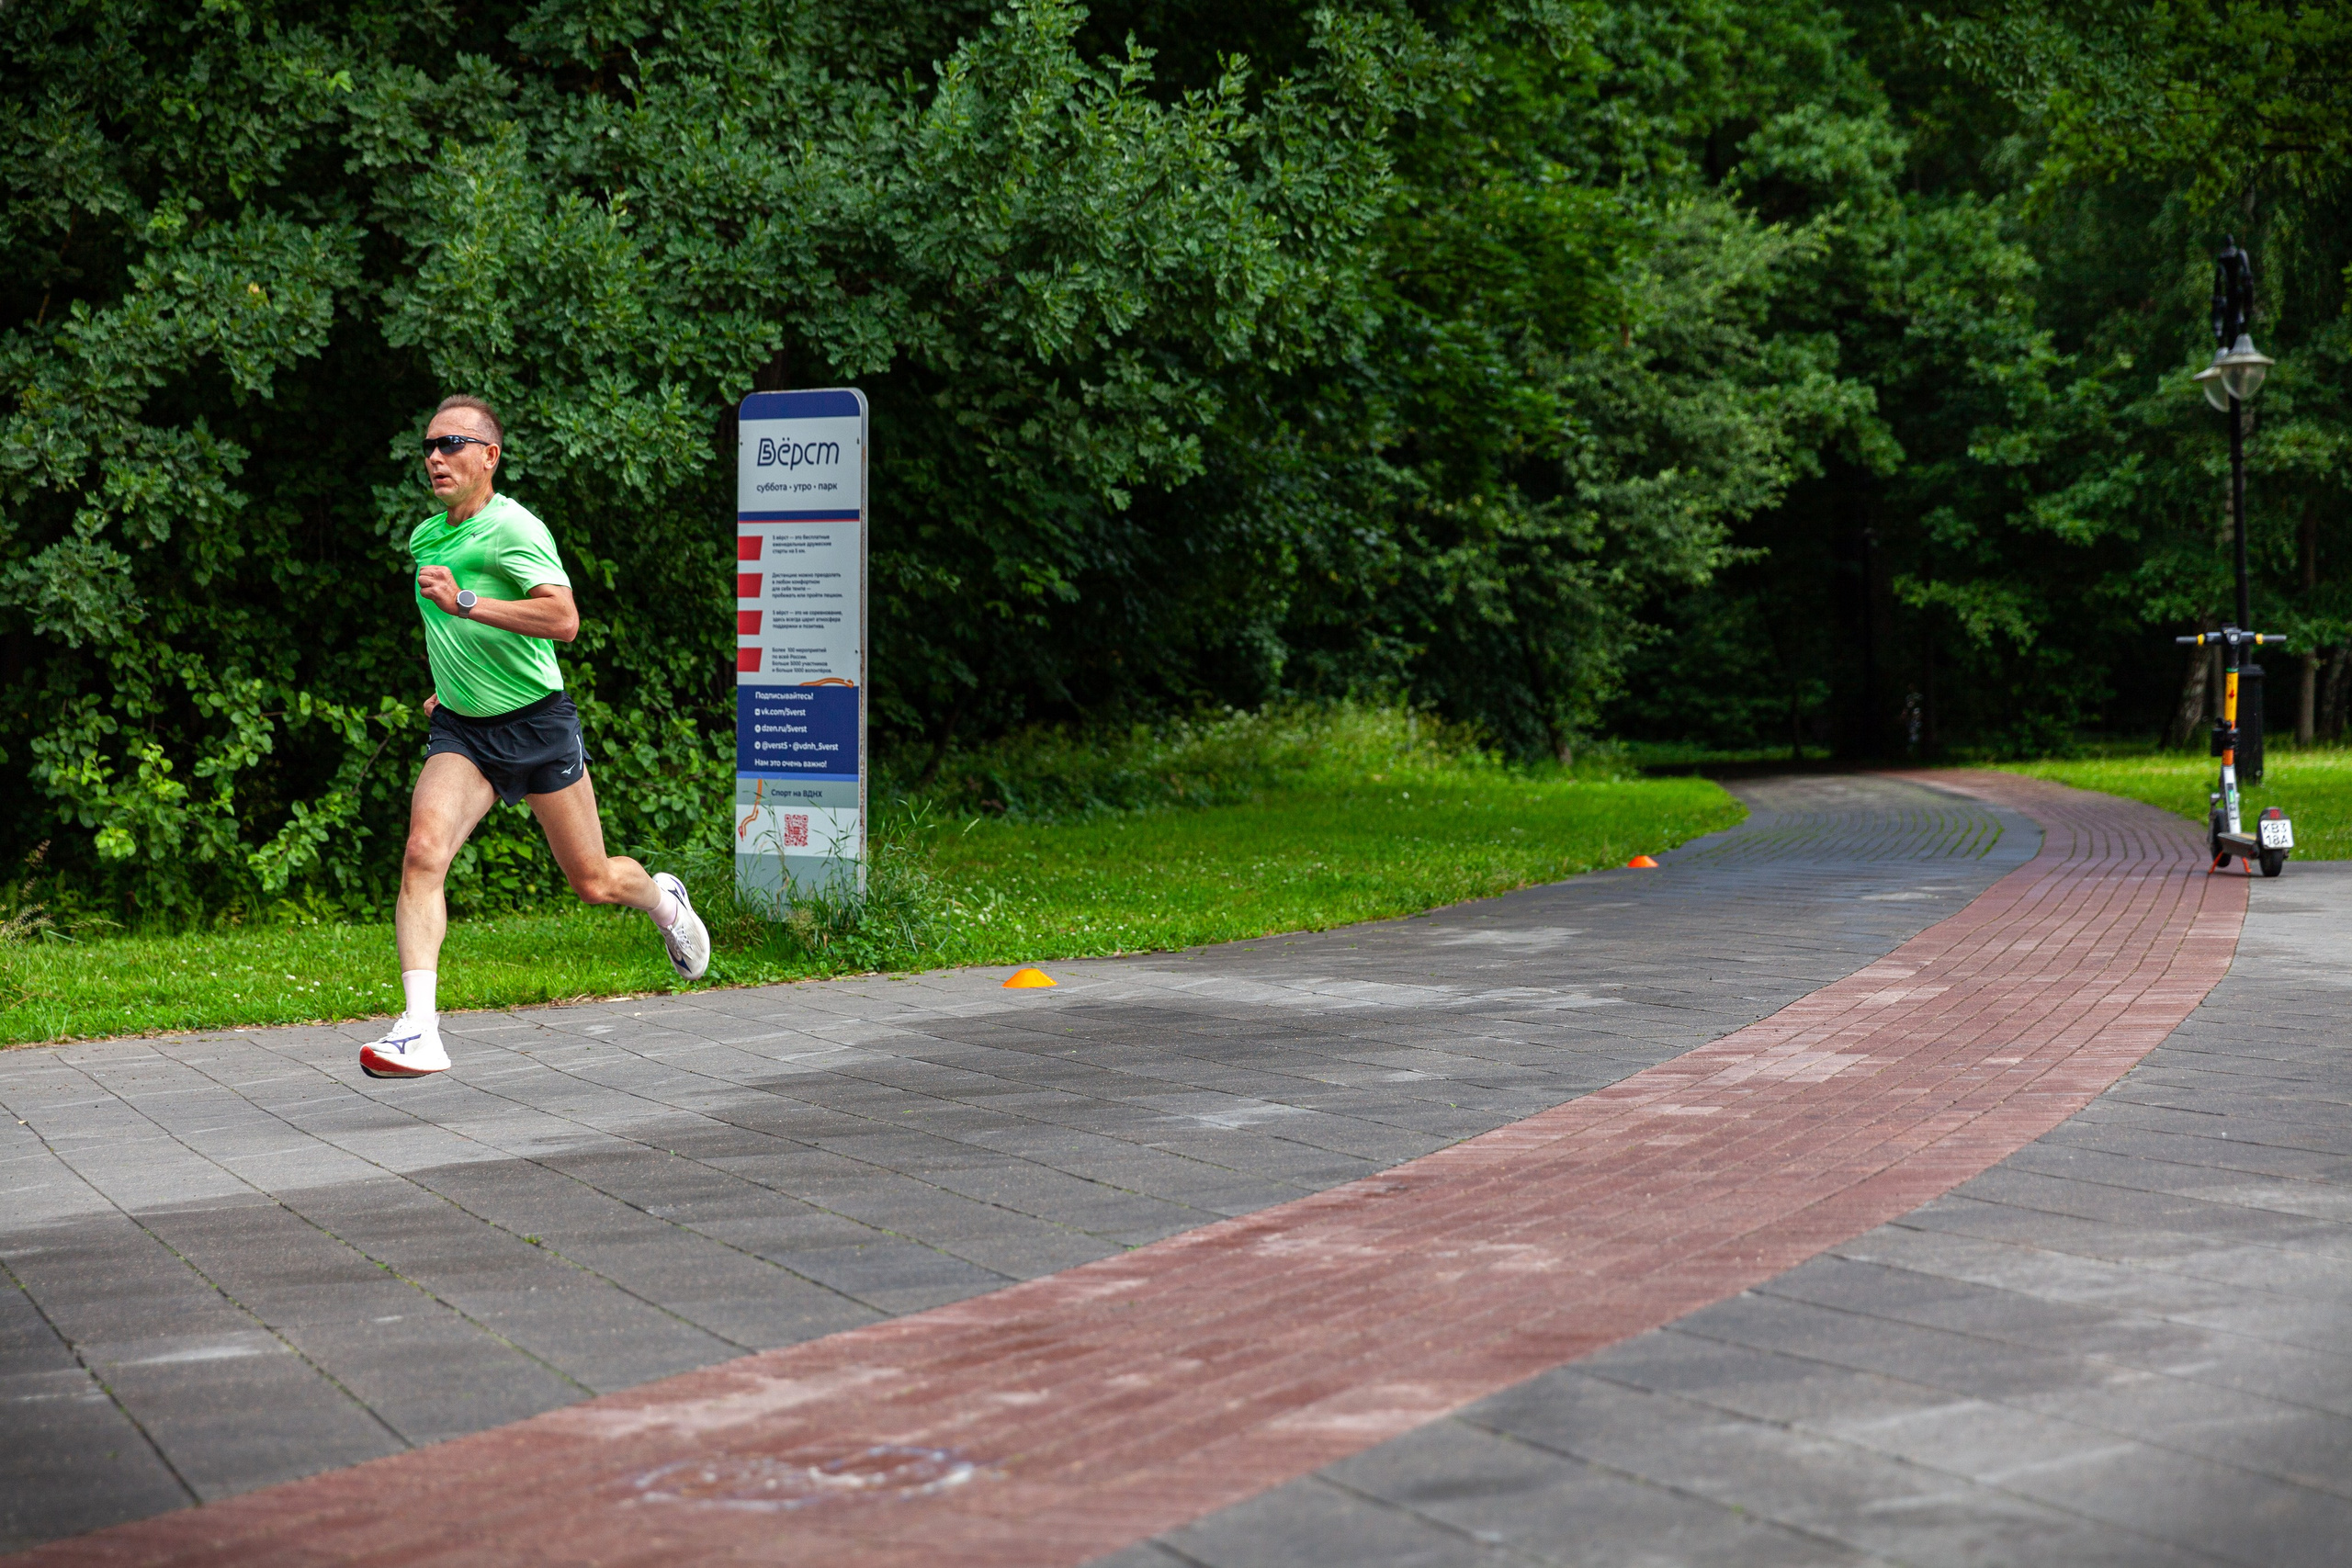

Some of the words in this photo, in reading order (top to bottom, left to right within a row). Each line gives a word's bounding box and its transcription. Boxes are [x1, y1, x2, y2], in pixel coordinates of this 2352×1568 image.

[756, 482, 787, 493] суббота
[794, 483, 811, 491] утро
[819, 482, 837, 491] парк
[755, 692, 814, 700] Подписывайтесь!
[762, 707, 806, 716] vk.com/5verst
[763, 725, 807, 733] dzen.ru/5verst
[771, 789, 791, 797] Спорт
[803, 790, 822, 798] ВДНХ
